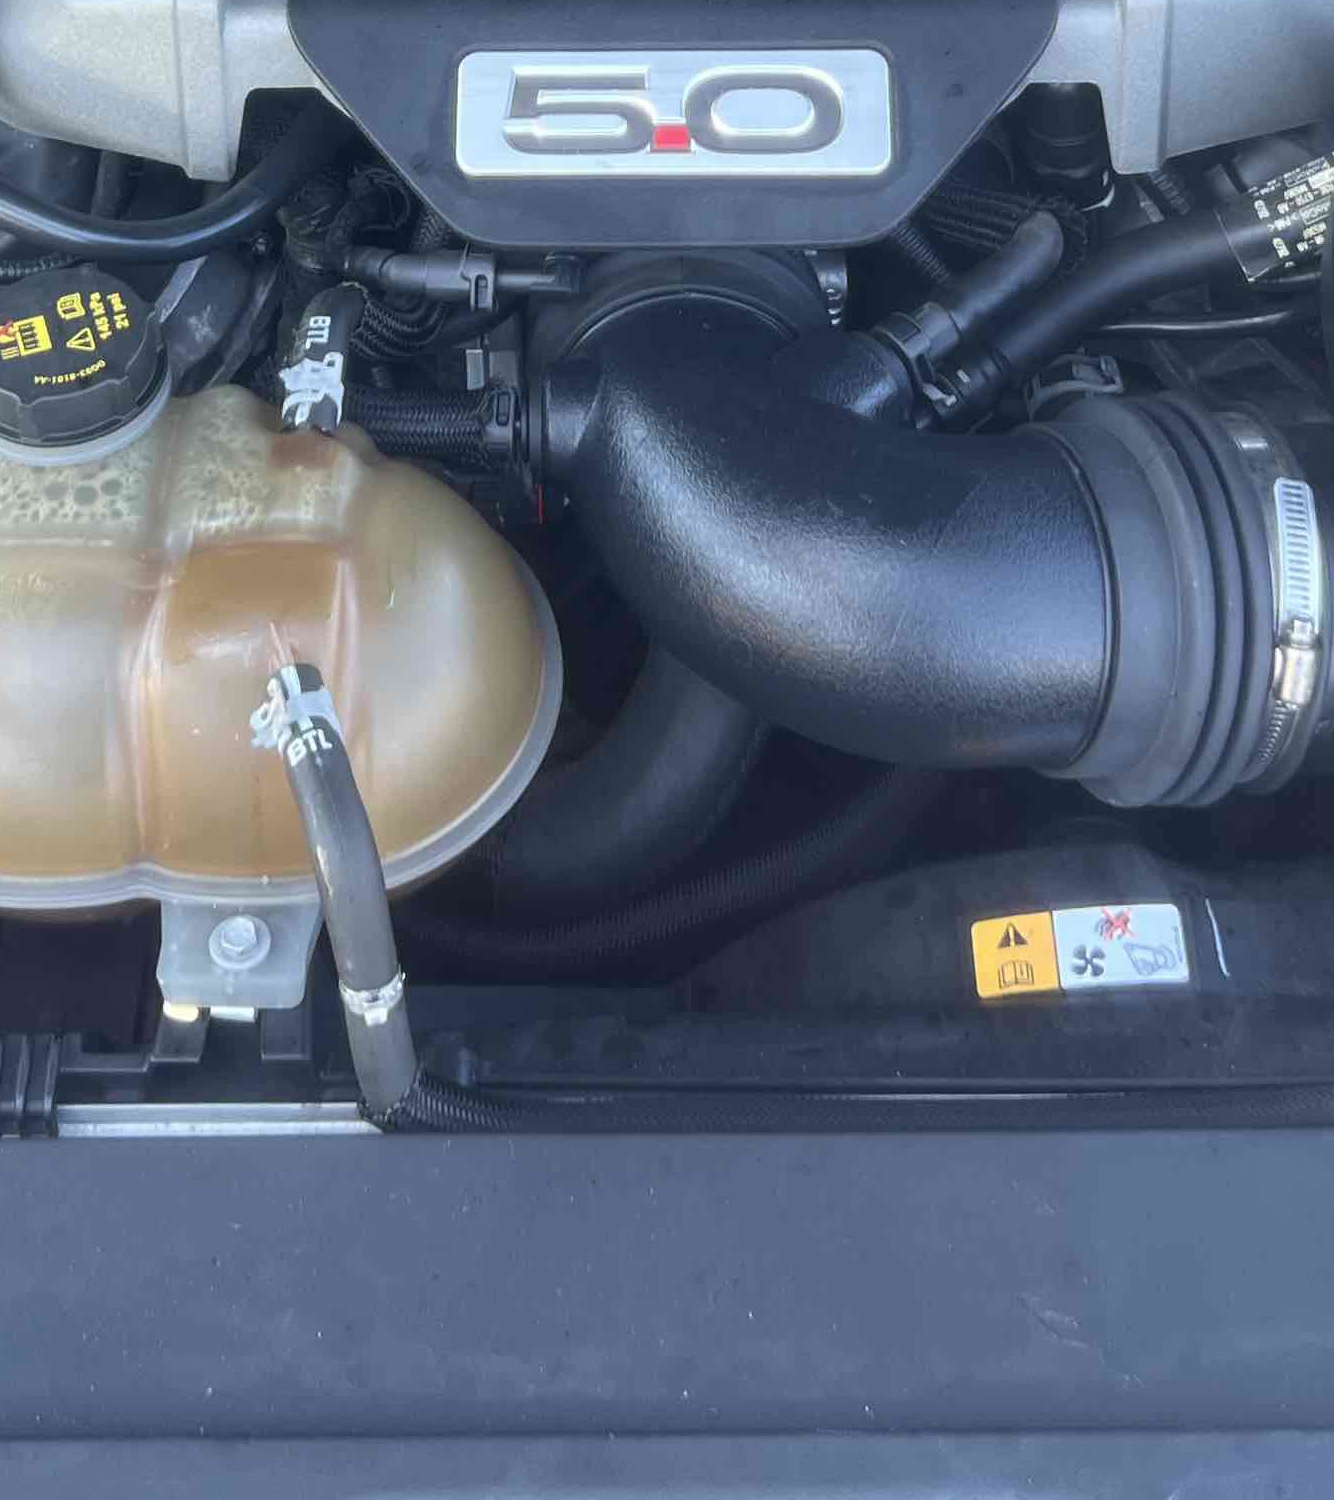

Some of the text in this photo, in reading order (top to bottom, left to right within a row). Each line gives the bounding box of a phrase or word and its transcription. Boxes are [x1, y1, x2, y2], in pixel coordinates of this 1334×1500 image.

[502, 63, 845, 156] 5.0
[306, 315, 331, 349] BTL
[288, 729, 333, 766] BTL
